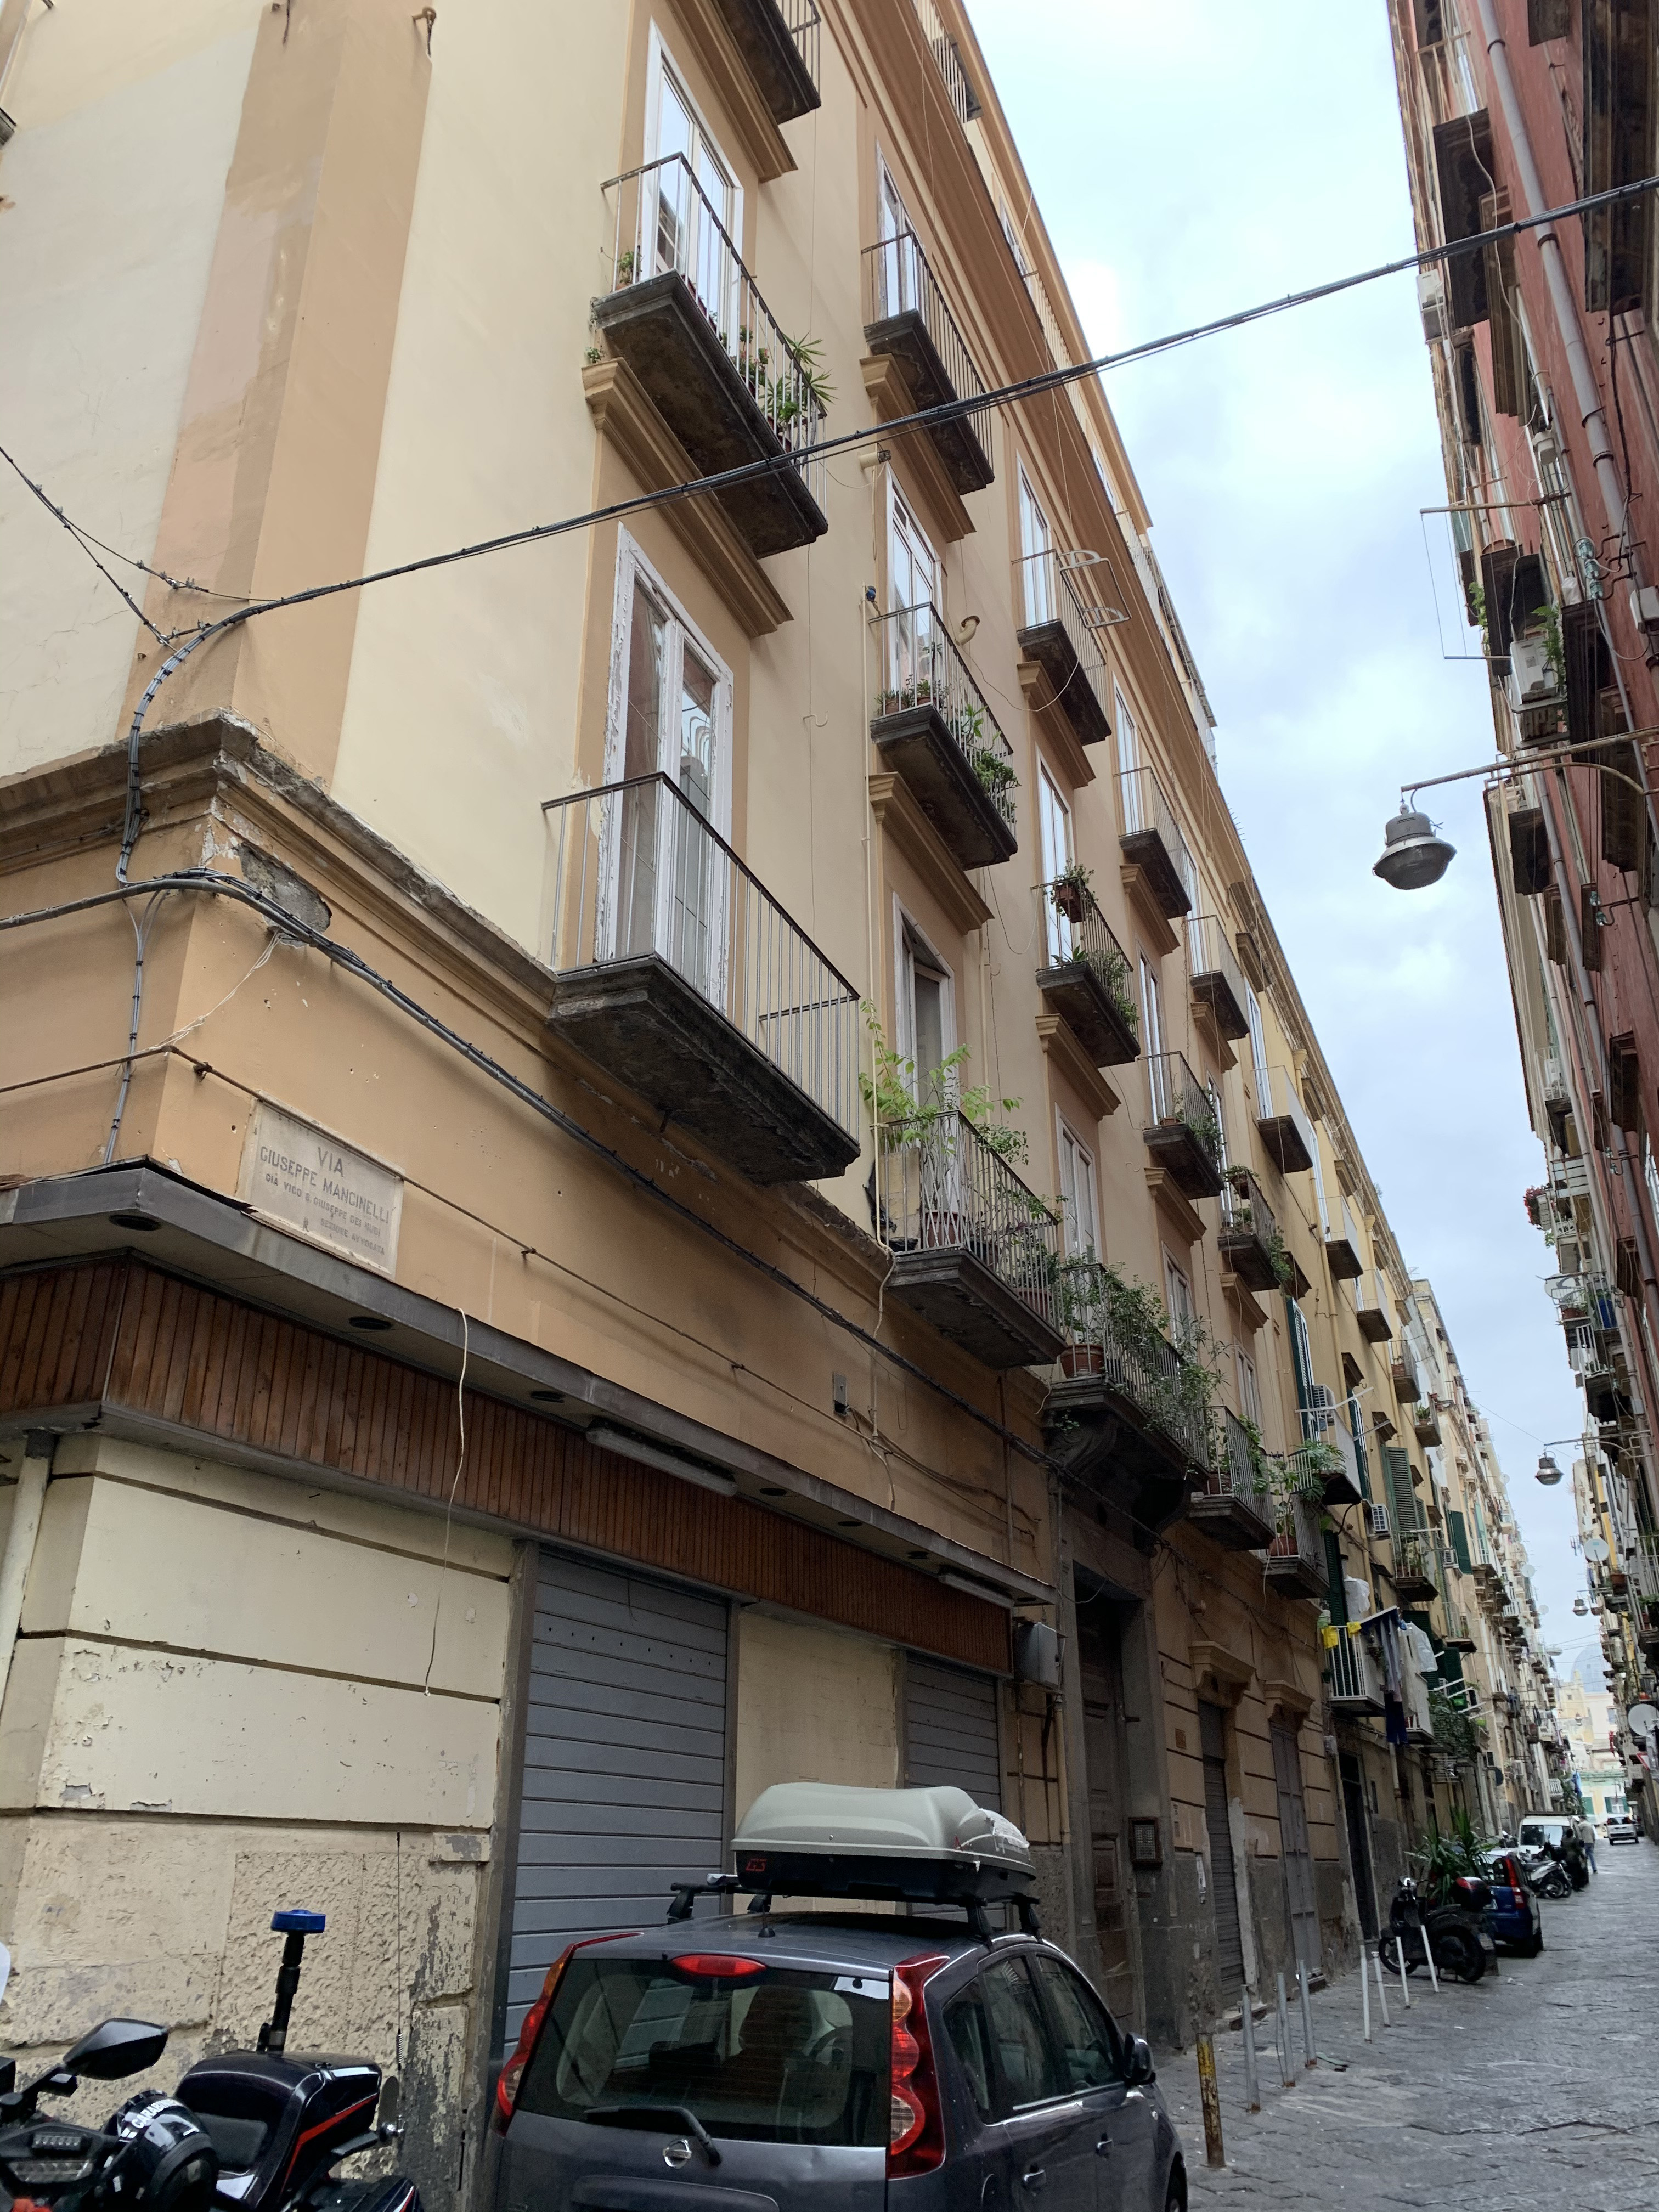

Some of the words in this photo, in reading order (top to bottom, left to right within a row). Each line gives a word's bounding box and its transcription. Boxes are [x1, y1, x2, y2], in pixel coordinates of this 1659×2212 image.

[261, 1146, 318, 1186] GIUSEPPE
[323, 1177, 389, 1224] MANCINELLI
[318, 1147, 343, 1177] VIA
[284, 1182, 302, 1197] VICO
[313, 1197, 347, 1220] GIUSEPPE
[350, 1215, 362, 1227] DEI
[364, 1222, 380, 1237] NUDI
[320, 1218, 348, 1238] SEZIONE
[352, 1233, 385, 1255] AVVOCATA
